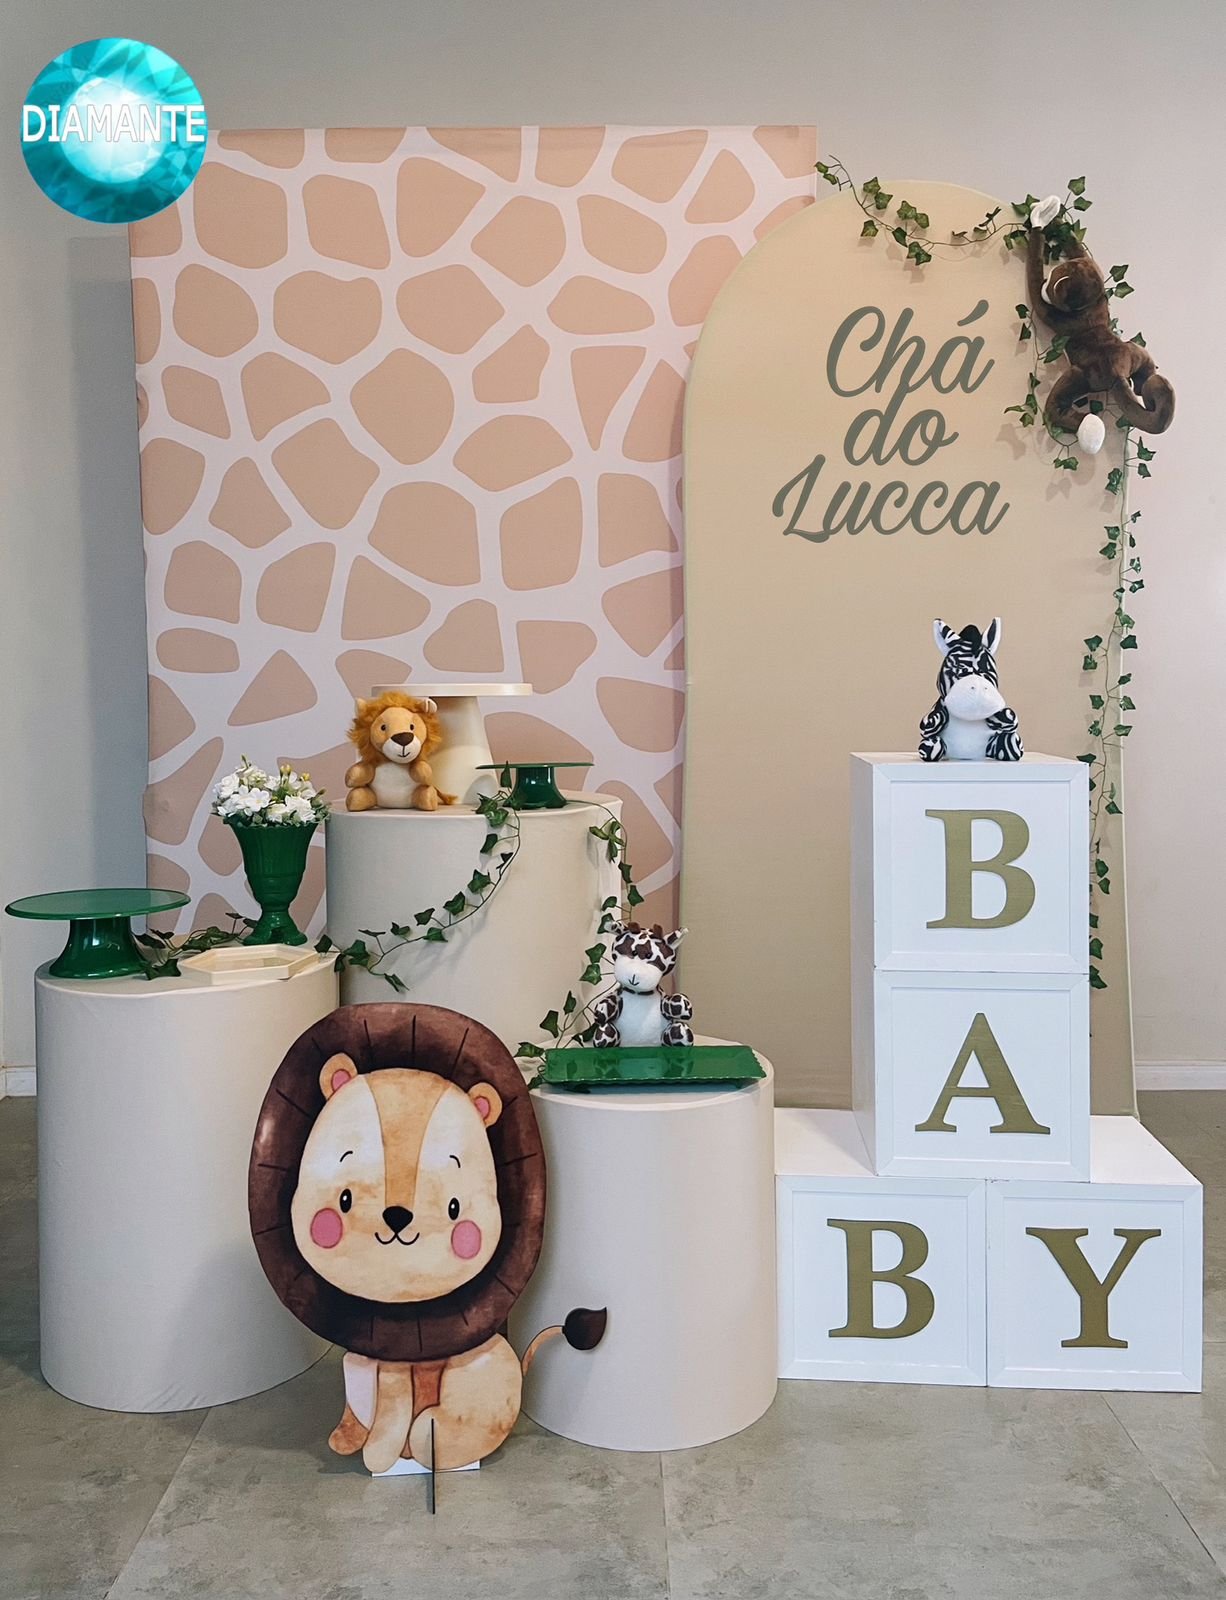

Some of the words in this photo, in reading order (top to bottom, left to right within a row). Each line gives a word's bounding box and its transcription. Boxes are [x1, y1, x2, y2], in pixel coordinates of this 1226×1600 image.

[826, 299, 995, 398] Chá
[843, 381, 960, 466] do
[772, 454, 1010, 543] Lucca
